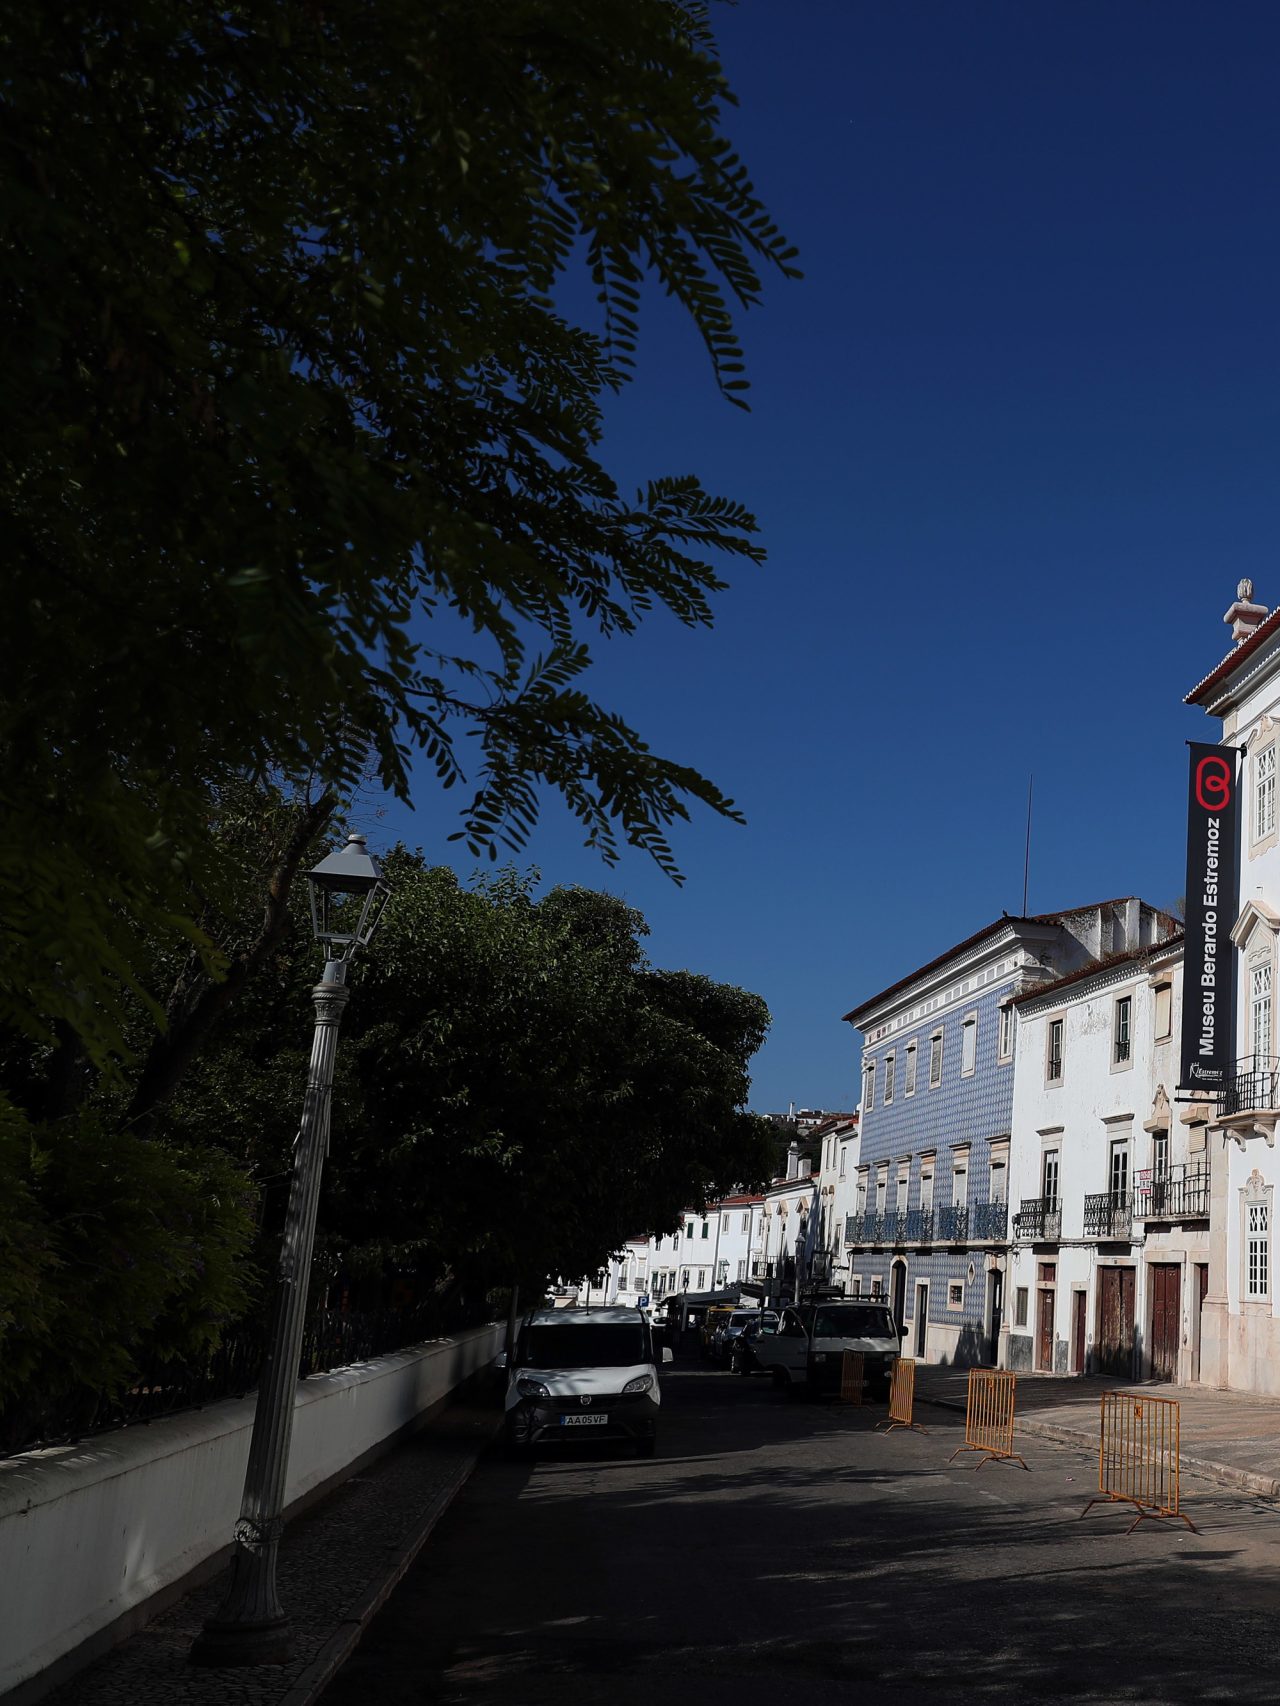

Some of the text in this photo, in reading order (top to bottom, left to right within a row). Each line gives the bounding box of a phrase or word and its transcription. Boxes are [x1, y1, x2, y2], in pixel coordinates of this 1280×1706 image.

[1199, 817, 1220, 1056] Museu Berardo Estremoz
[640, 1297, 648, 1307] P
